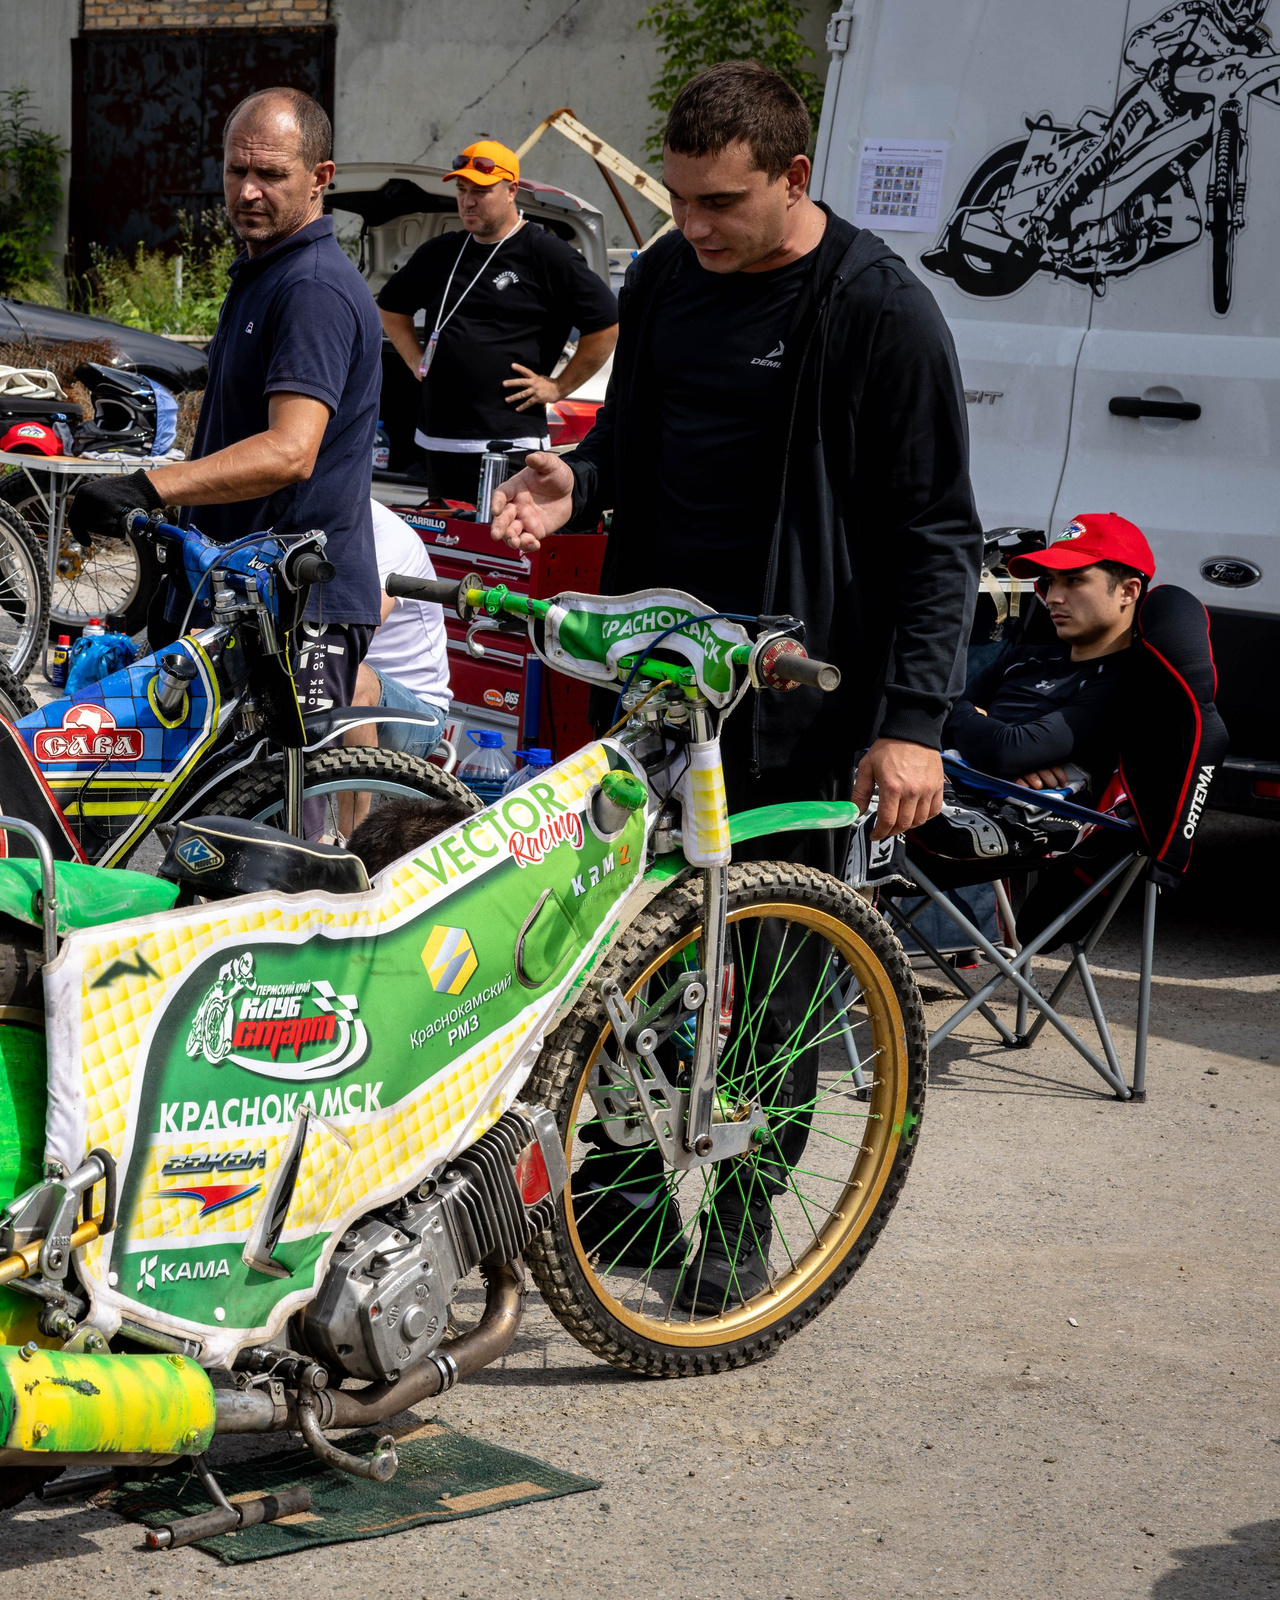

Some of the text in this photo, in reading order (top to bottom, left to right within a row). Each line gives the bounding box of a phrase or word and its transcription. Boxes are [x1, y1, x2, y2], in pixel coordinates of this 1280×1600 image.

[1216, 62, 1246, 81] #76
[1021, 152, 1057, 176] #76
[751, 358, 782, 369] DEMI
[407, 514, 446, 529] CARRILLO
[1183, 764, 1215, 840] ORTEMA
[412, 780, 568, 886] VECTOR
[509, 808, 584, 868] Racing
[256, 980, 311, 996] ПЕРМСКИЙ КРАЙ
[240, 995, 302, 1019] КЛУБ
[409, 971, 513, 1050] Краснокамский
[447, 1014, 481, 1048] РМЗ
[159, 1081, 384, 1134] КРАСНОКАМСК
